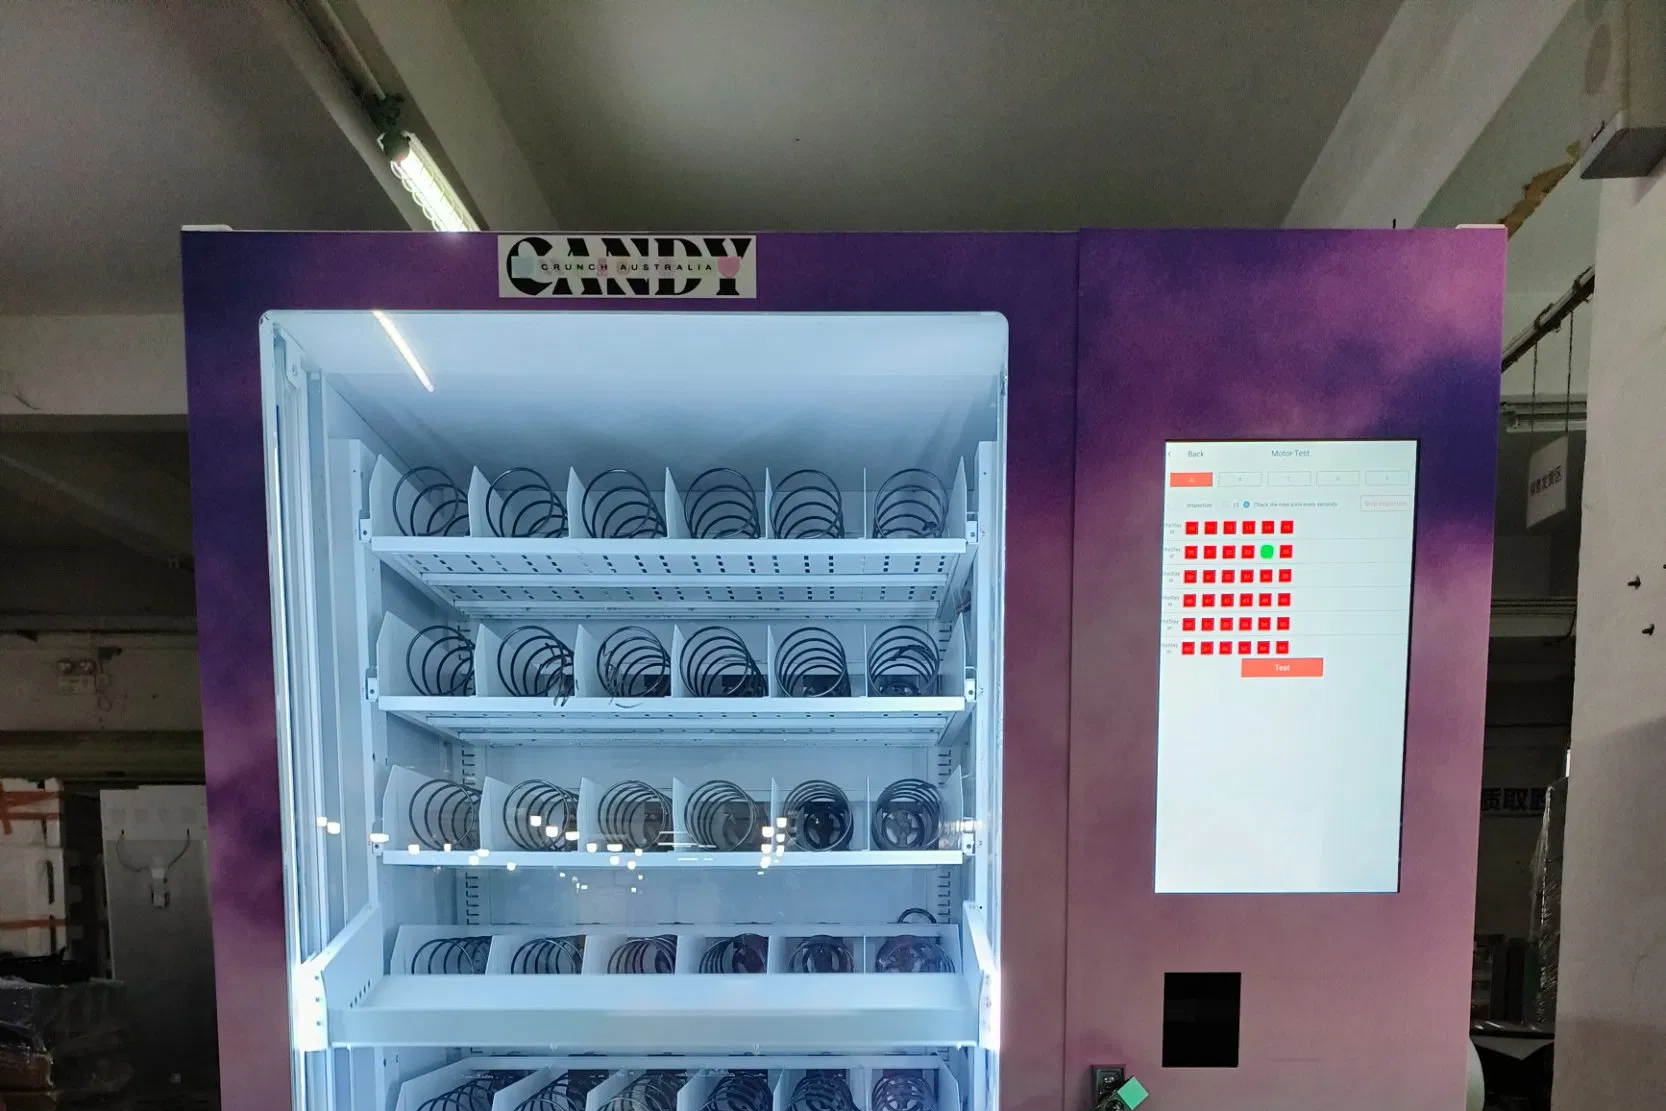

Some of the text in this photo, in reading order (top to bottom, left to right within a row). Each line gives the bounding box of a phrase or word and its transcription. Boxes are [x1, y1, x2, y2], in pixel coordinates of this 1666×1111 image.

[506, 236, 752, 296] CANDY
[541, 263, 713, 271] CRUNCH AUSTRALIA
[1187, 449, 1204, 458] Back
[1271, 449, 1310, 457] Motor Test
[1274, 664, 1290, 672] Test
